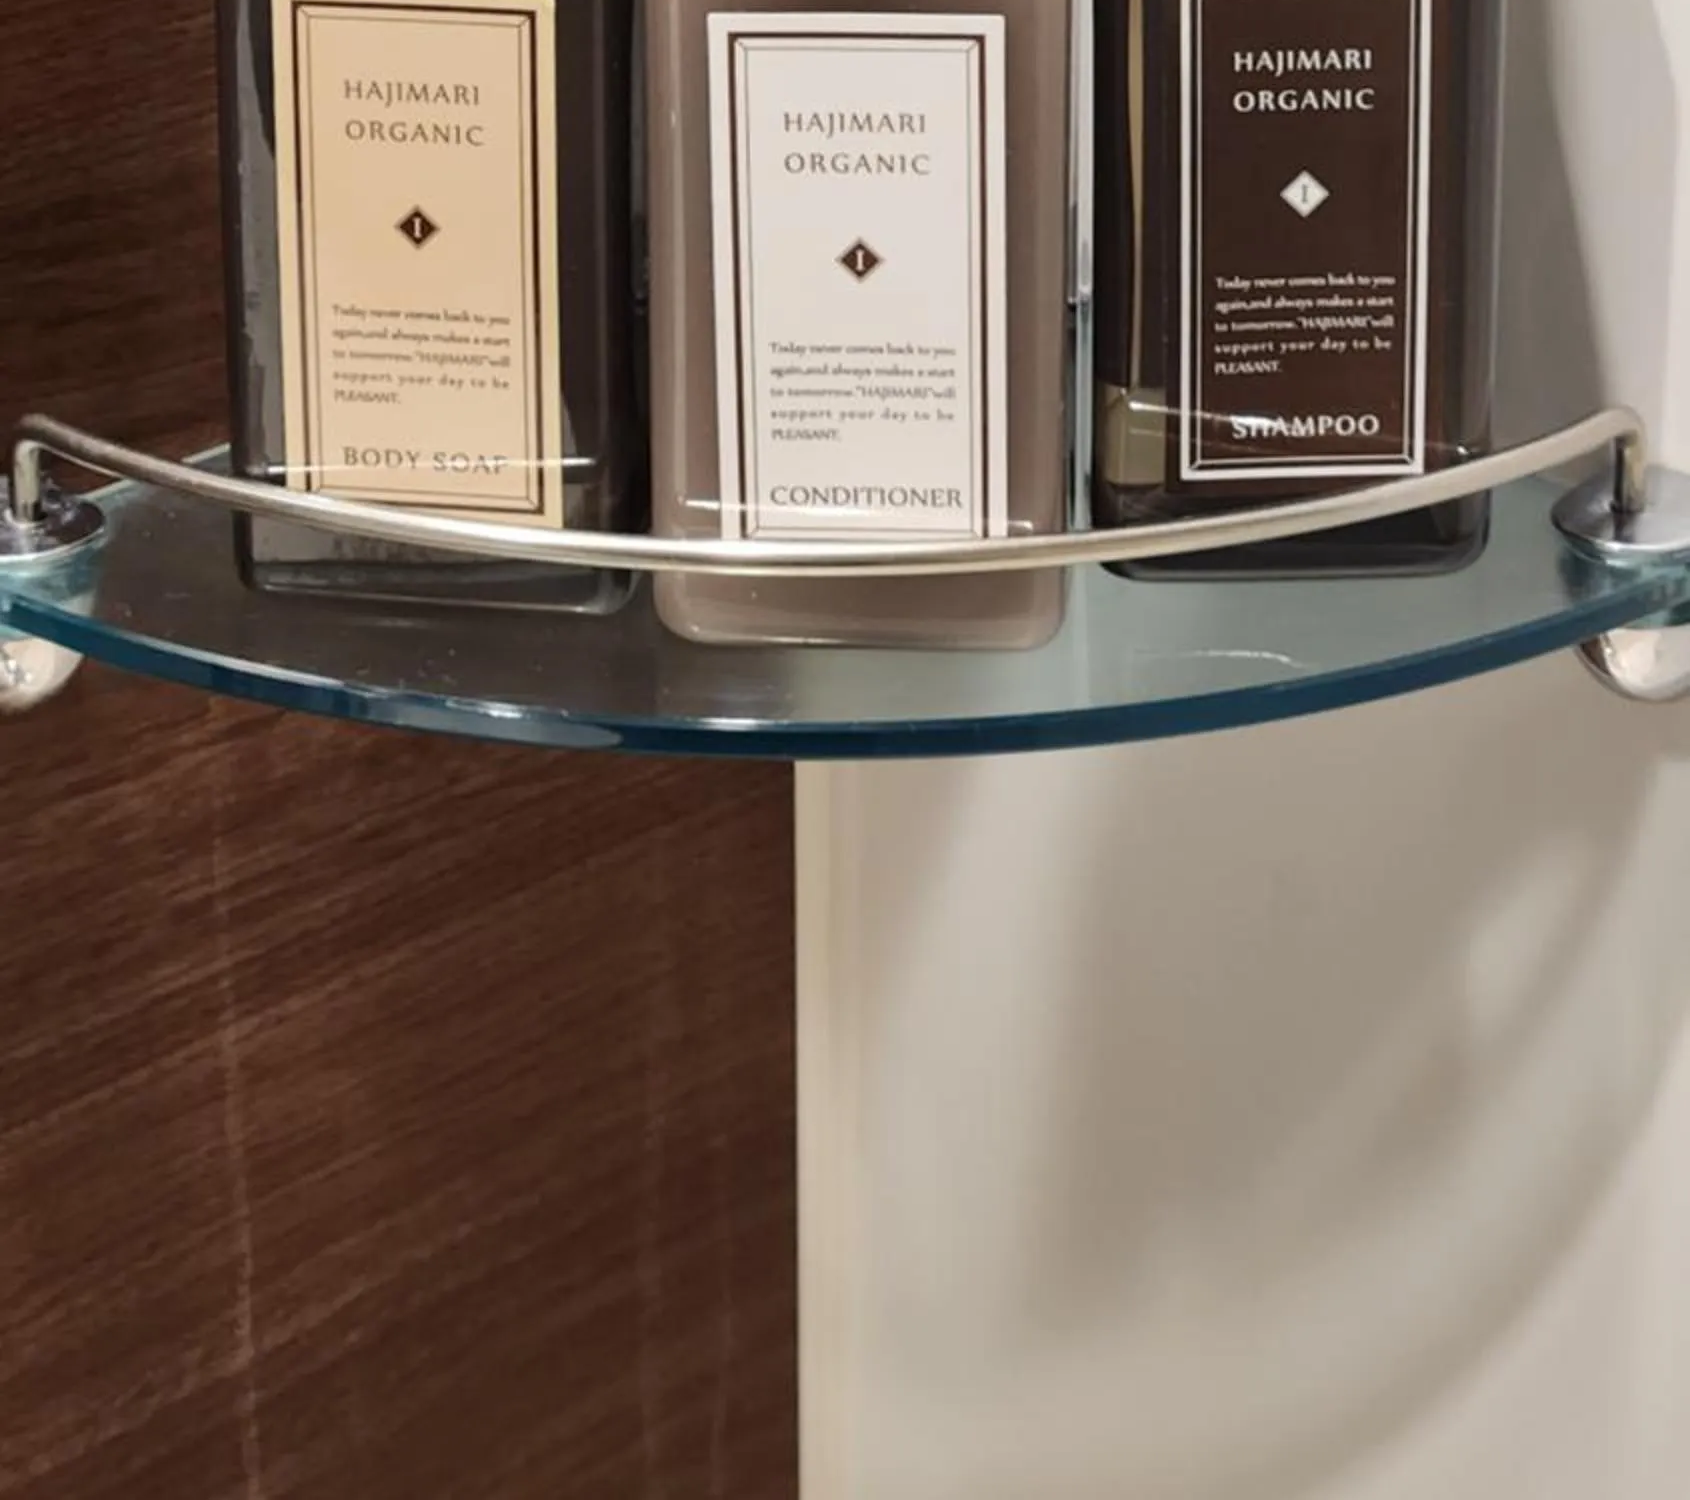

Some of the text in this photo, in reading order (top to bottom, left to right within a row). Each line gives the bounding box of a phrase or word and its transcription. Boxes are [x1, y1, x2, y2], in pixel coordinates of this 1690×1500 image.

[1233, 49, 1372, 77] HAJIMARI
[344, 79, 480, 108] HAJIMARI
[1233, 88, 1375, 112] ORGANIC
[345, 119, 485, 147] ORGANIC
[783, 112, 926, 139] HAJIMARI
[784, 152, 931, 176] ORGANIC
[1215, 276, 1251, 292] Today
[1328, 272, 1355, 286] back
[1357, 275, 1370, 286] to
[1372, 276, 1396, 289] you
[1215, 322, 1228, 332] to
[768, 341, 806, 357] Today
[886, 341, 913, 355] back
[918, 344, 930, 354] to
[933, 346, 956, 360] you
[1215, 336, 1391, 357] support your day to be
[333, 371, 510, 391] support your day to be
[770, 387, 784, 397] to
[770, 407, 955, 424] support your day to be
[1231, 413, 1380, 439] SHAMPOO
[342, 445, 508, 475] BODY SOAP
[770, 485, 962, 508] CONDITIONER
